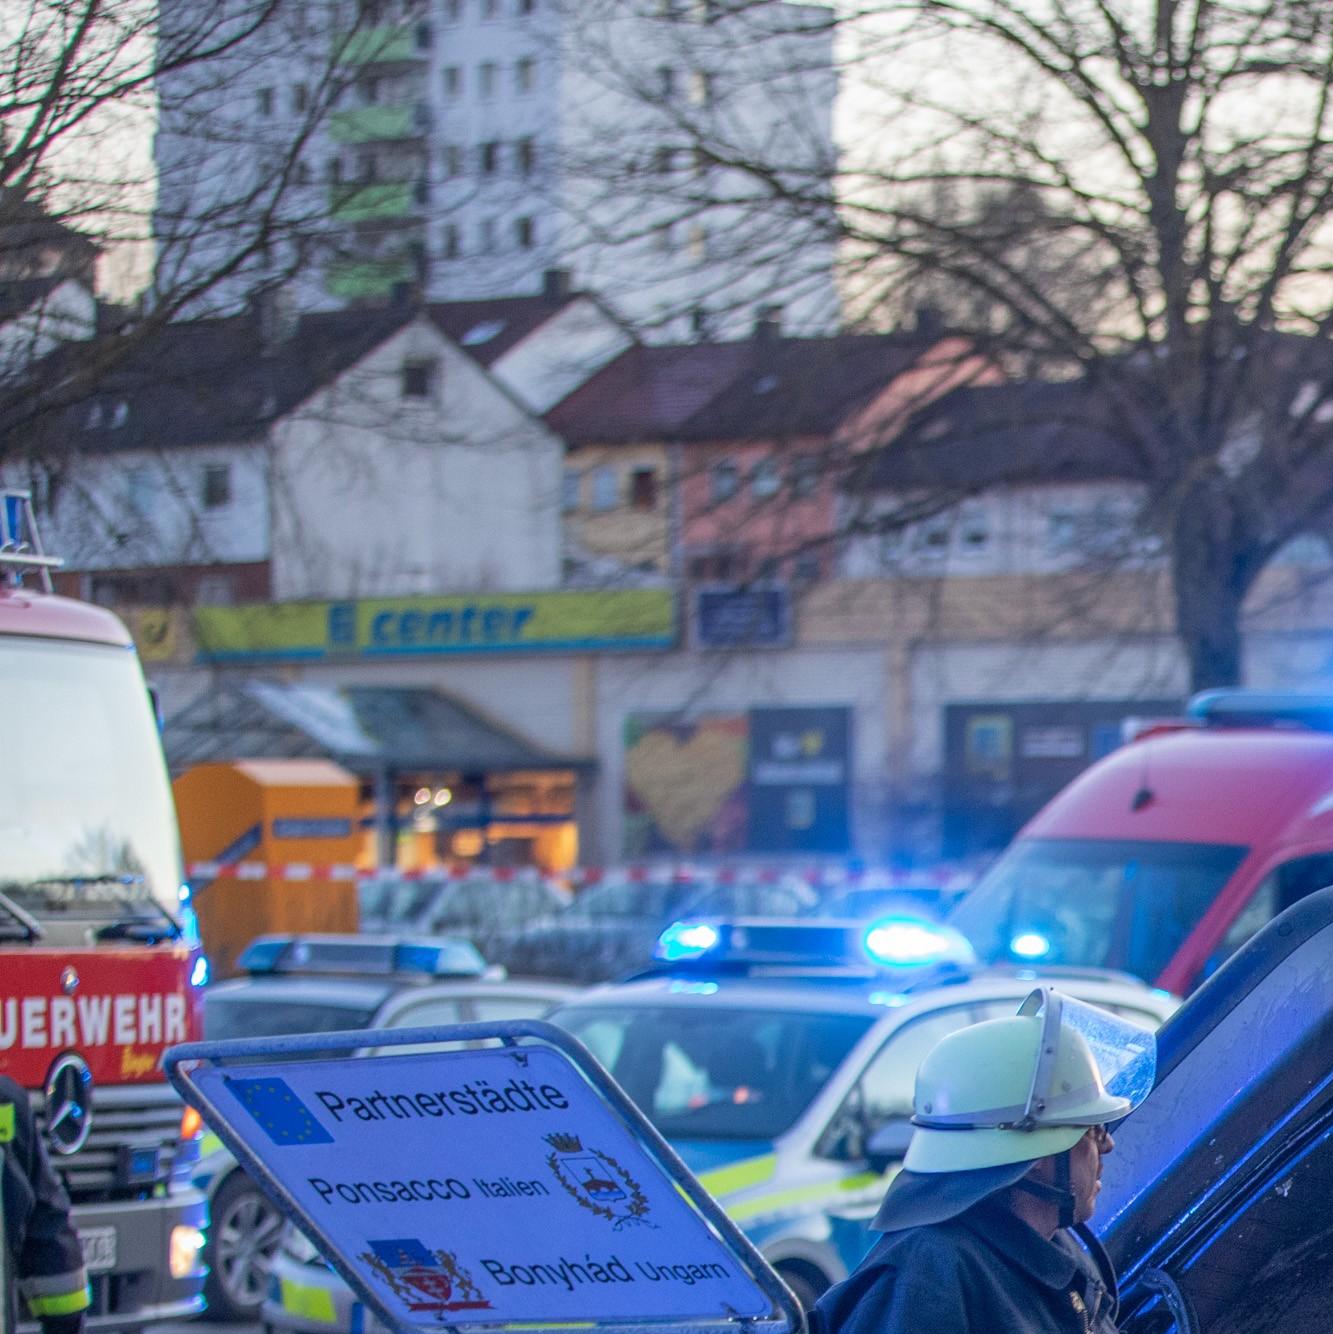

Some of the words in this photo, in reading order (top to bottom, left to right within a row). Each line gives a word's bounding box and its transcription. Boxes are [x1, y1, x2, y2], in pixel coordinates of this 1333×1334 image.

[371, 605, 535, 643] center
[315, 1080, 571, 1123] Partnerstädte
[308, 1176, 471, 1205] Ponsacco
[472, 1175, 550, 1200] Italien
[480, 1256, 638, 1292] Bonyhád
[644, 1259, 731, 1287] Ungarn
